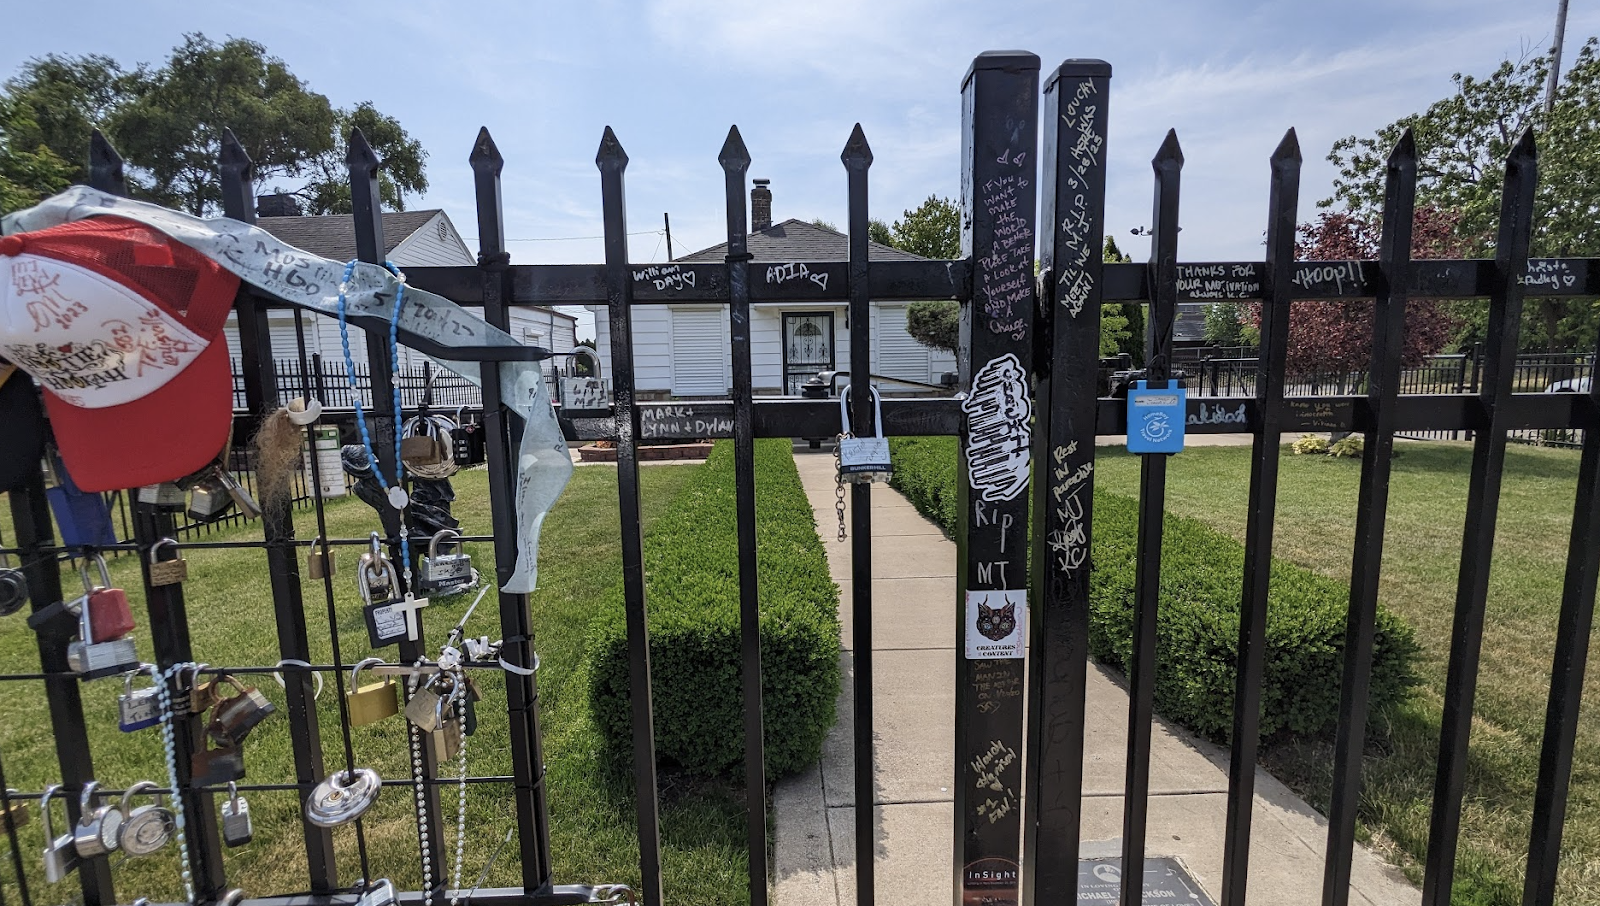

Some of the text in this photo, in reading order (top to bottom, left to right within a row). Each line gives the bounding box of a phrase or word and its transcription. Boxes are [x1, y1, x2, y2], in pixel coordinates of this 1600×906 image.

[993, 240, 1000, 251] A
[1176, 263, 1256, 279] THANKS FOR
[641, 420, 680, 437] LYNN
[969, 871, 1016, 880] InSight
[1142, 889, 1176, 898] CKSON
